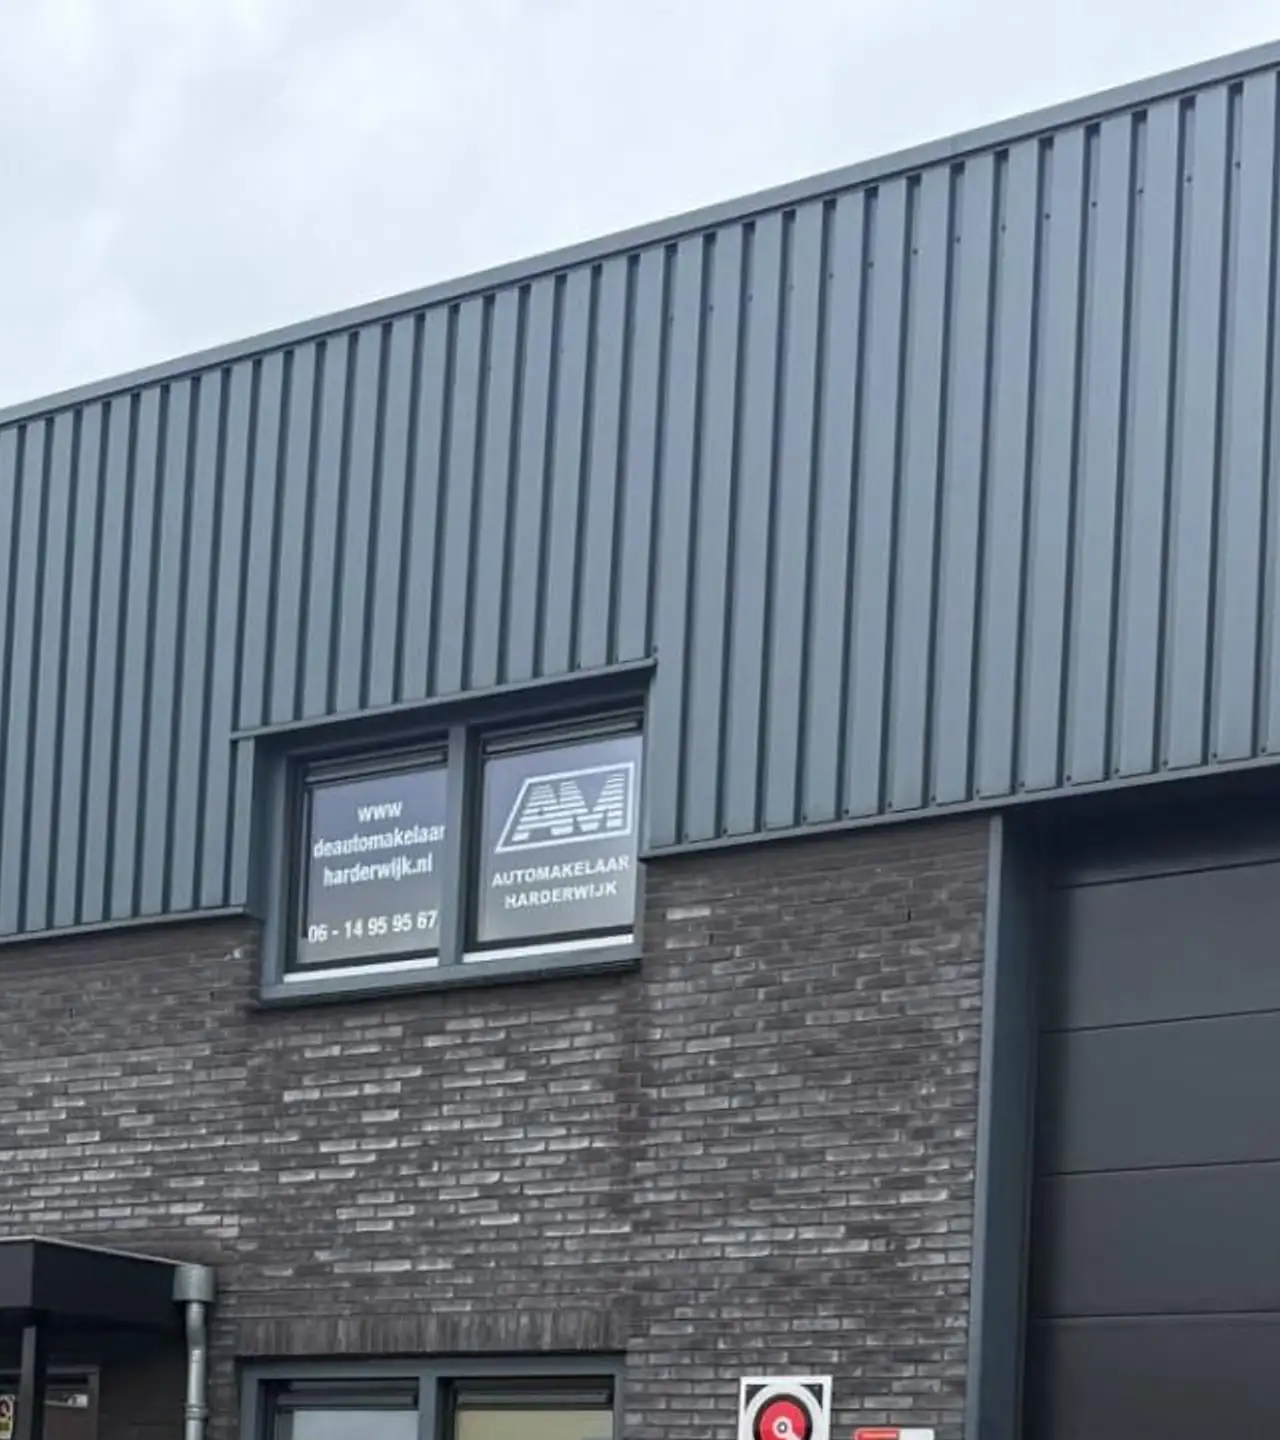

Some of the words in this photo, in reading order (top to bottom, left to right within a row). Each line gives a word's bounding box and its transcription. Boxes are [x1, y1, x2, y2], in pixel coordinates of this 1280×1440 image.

[357, 801, 403, 823] www
[313, 824, 446, 859] deautomakelaar
[323, 852, 434, 888] harderwijk.nl
[491, 855, 631, 888] AUTOMAKELAAR
[503, 881, 618, 909] HARDERWIJK
[307, 924, 328, 944] 06
[345, 920, 363, 939] 14
[367, 917, 388, 937] 95
[392, 914, 413, 933] 95
[417, 910, 438, 930] 67
